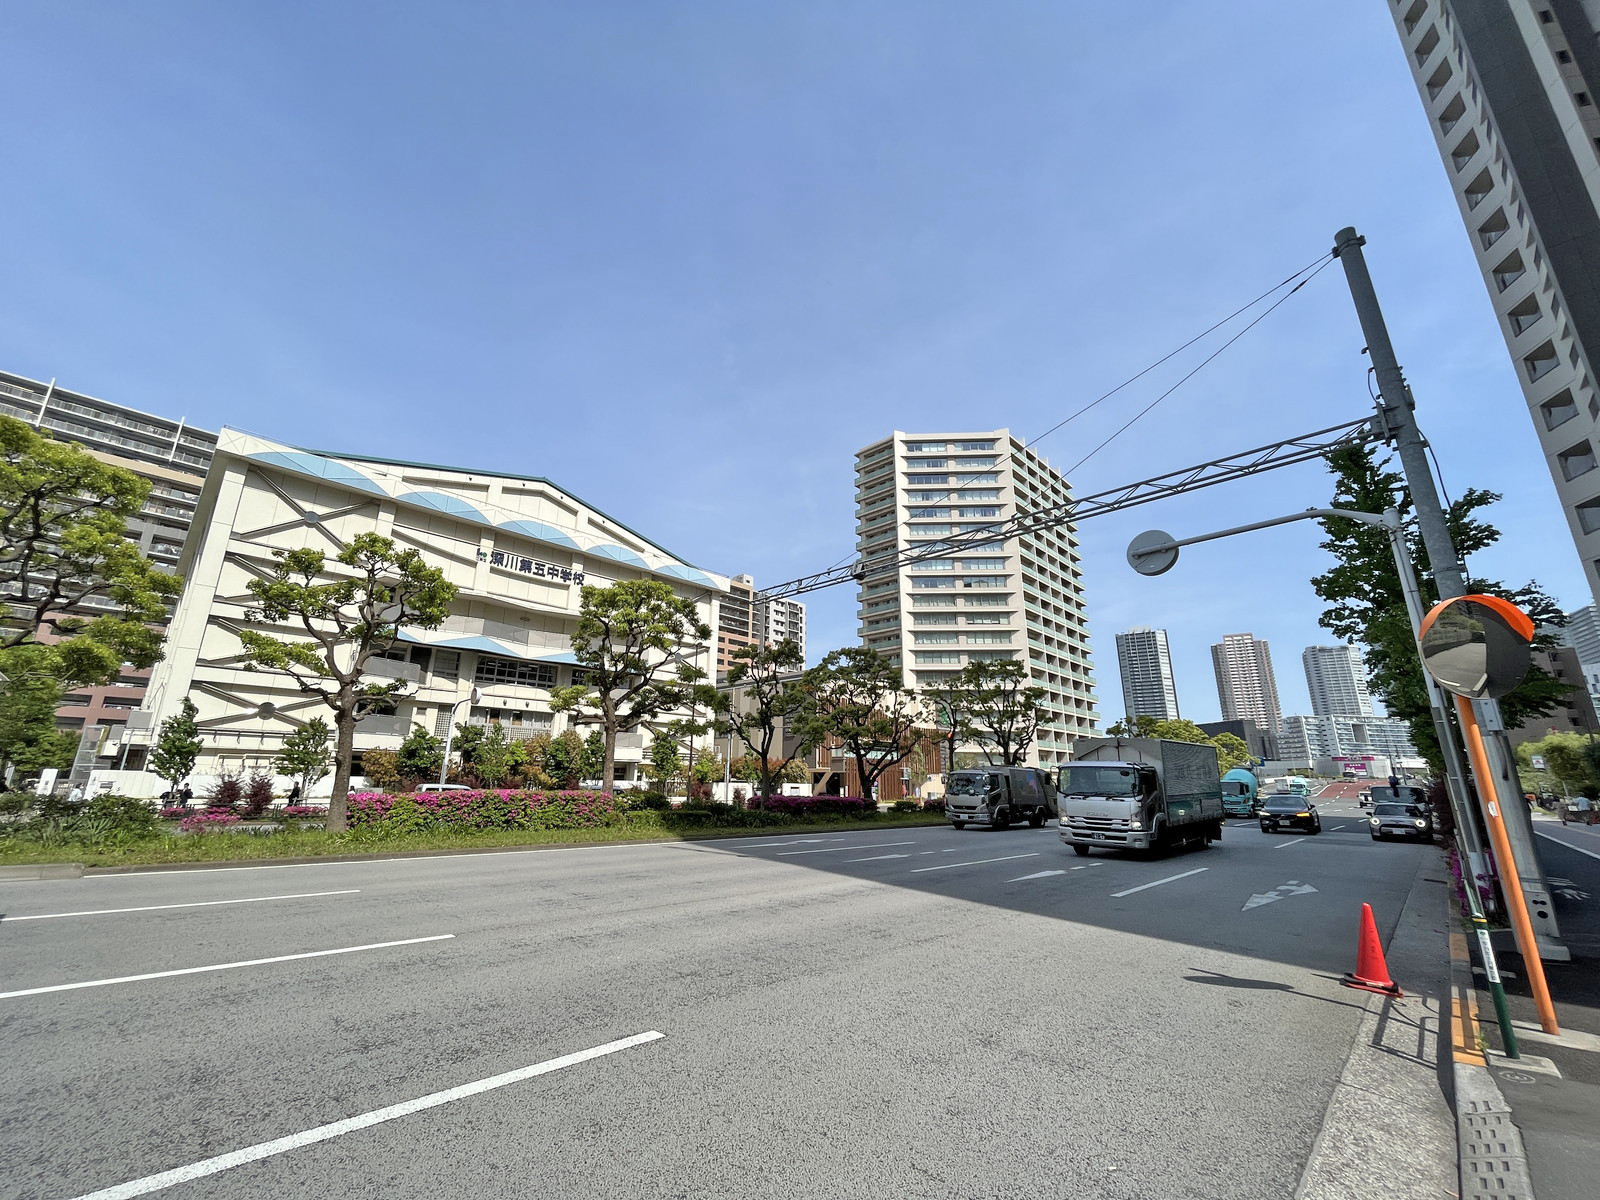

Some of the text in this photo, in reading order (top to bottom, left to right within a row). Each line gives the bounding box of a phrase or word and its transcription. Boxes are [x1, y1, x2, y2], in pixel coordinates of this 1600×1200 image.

[490, 550, 585, 586] 深川第五中学校
